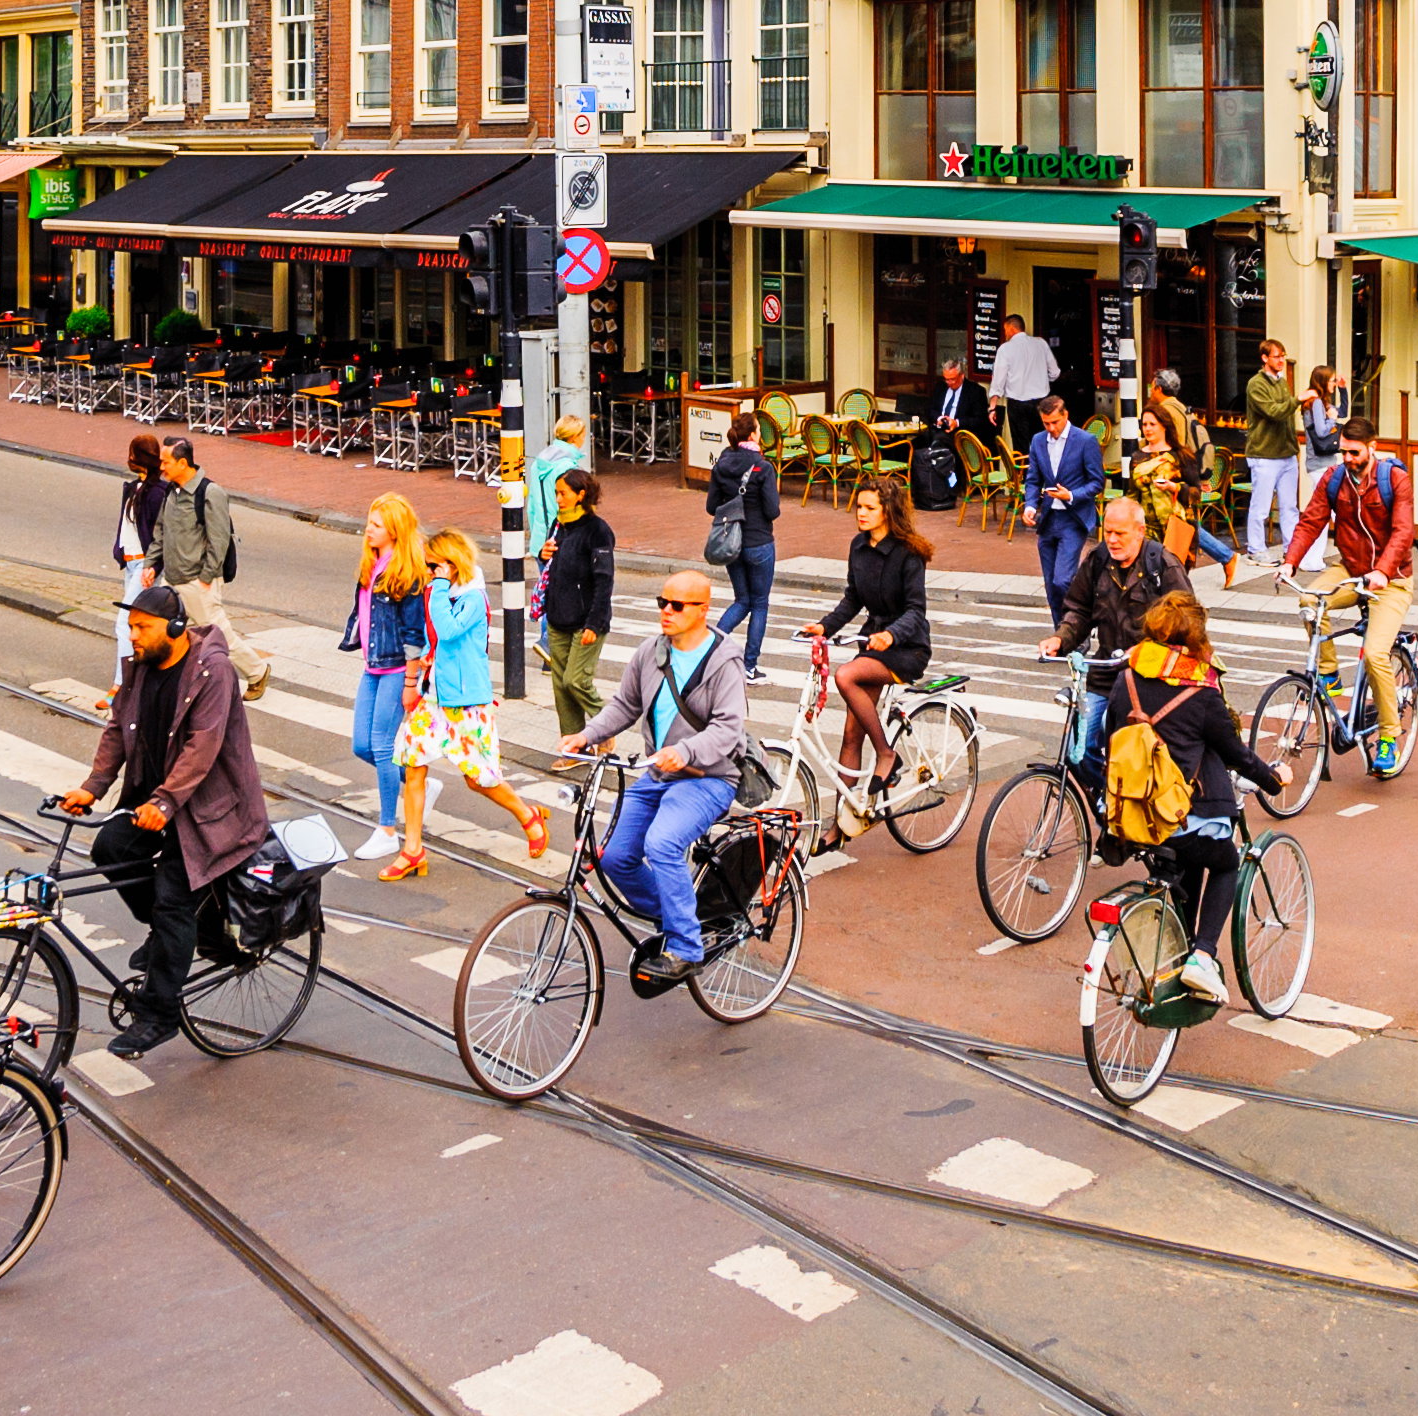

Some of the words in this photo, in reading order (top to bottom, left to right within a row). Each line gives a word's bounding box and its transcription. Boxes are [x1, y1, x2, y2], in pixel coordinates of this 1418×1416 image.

[589, 10, 632, 24] GASSAN
[971, 144, 1119, 180] Heineken
[45, 177, 71, 193] ibis
[41, 193, 75, 204] STYLES
[281, 190, 389, 215] FLAME
[199, 241, 246, 257] BRASSERIE
[259, 245, 286, 260] GRILL
[289, 246, 352, 263] RESTAURANT
[417, 251, 470, 269] BRASSERI
[690, 408, 713, 421] AMSTEL
